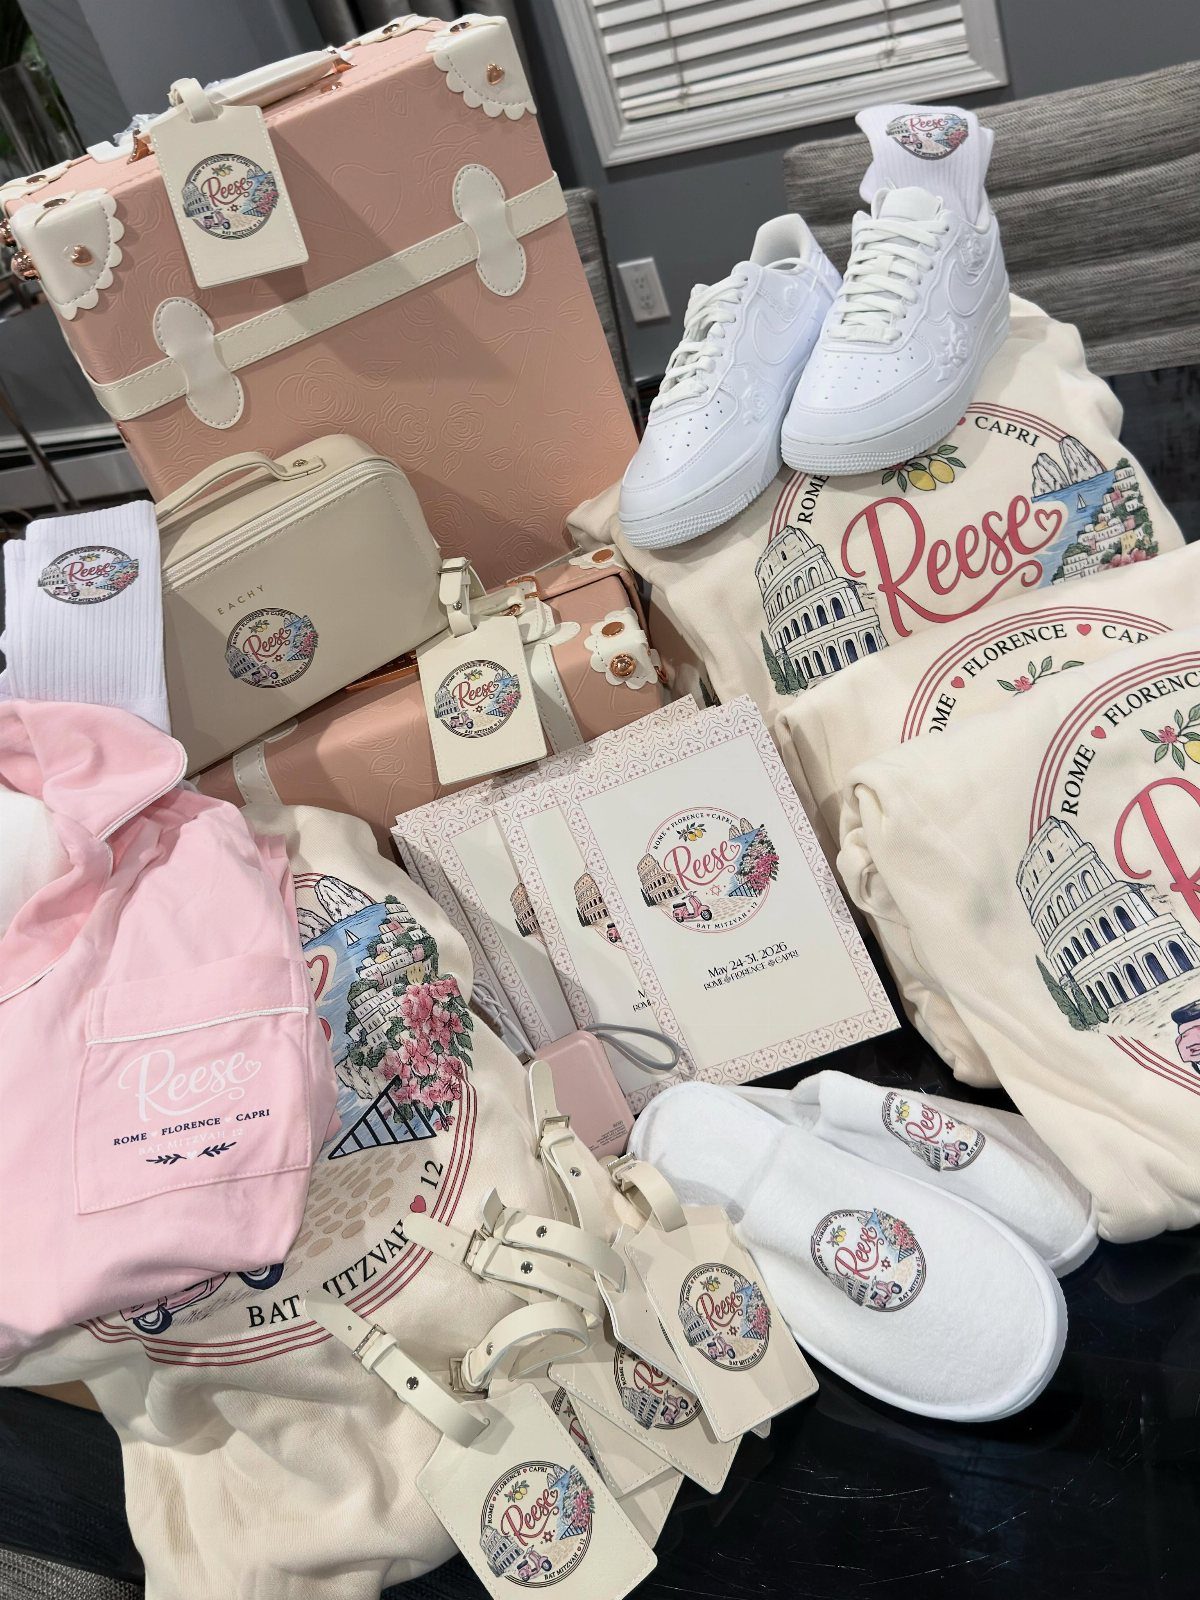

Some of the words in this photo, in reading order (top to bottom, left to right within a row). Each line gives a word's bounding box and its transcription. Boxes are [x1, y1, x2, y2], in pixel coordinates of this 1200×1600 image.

[904, 117, 949, 132] Reese
[201, 176, 253, 207] Reese
[797, 474, 830, 525] ROME
[975, 416, 1040, 448] CAPRI
[62, 561, 116, 582] Reese
[841, 495, 1062, 637] Reese
[217, 585, 264, 616] EACHY
[243, 628, 292, 662] Reese
[452, 681, 500, 708] Reese
[929, 693, 957, 734] OME
[961, 624, 1067, 678] FLORENCE
[1102, 625, 1149, 645] CAP
[1061, 744, 1096, 816] ROME
[1102, 671, 1200, 727] FLORENC
[653, 832, 667, 850] ROME
[671, 812, 704, 828] FLORENCE
[711, 813, 733, 825] CAPRI
[664, 841, 740, 891] Reese
[714, 913, 748, 929] MITZVAH
[708, 965, 728, 979] May
[761, 941, 788, 960] 2026
[774, 949, 799, 964] CAPRI
[118, 1049, 262, 1122] Reese
[113, 1132, 147, 1146] ROME
[161, 1117, 221, 1136] FLORENCE
[235, 1109, 270, 1122] CAPRI
[168, 1131, 225, 1149] MITZVAH
[246, 1294, 301, 1328] BAT
[421, 1160, 444, 1190] 12
[835, 1226, 885, 1280] Reese
[696, 1291, 743, 1332] Reese
[898, 1292, 910, 1302] BAT
[487, 1503, 495, 1524] ROME
[495, 1470, 522, 1496] FLORENCE
[500, 1488, 559, 1546] Reese
[544, 1571, 556, 1581] BAT
[556, 1552, 579, 1575] MITZVAH
